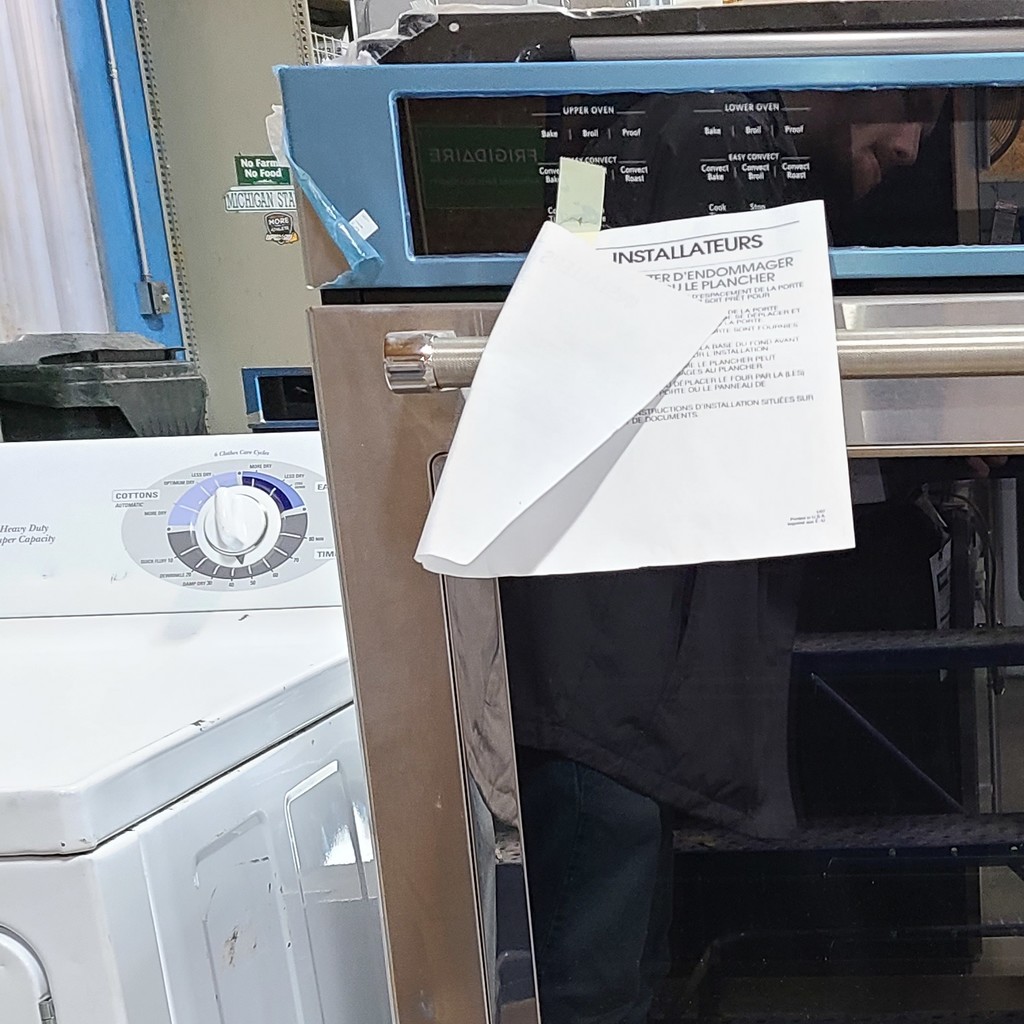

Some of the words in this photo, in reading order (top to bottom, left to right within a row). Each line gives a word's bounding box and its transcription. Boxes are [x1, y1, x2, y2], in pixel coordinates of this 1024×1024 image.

[563, 106, 589, 115] UPPER
[591, 106, 615, 115] OVEN
[725, 103, 754, 112] LOWER
[756, 103, 780, 111] OVEN
[582, 129, 598, 138] Broil
[622, 128, 641, 137] Proof
[704, 127, 722, 136] Bake
[745, 126, 762, 134] Broil
[784, 125, 804, 134] Proof
[541, 130, 558, 139] Bake
[728, 153, 746, 161] EASY
[747, 152, 780, 160] CONVECT
[241, 159, 254, 168] No
[256, 159, 280, 168] Farm
[741, 163, 770, 172] Convect
[782, 162, 810, 171] Convect
[244, 169, 258, 178] No
[260, 168, 282, 178] Food
[539, 167, 560, 175] Conve
[620, 166, 648, 174] Convect
[701, 164, 729, 173] Convect
[545, 175, 559, 184] Bak
[625, 174, 644, 182] Roast
[707, 173, 724, 181] Bake
[748, 172, 764, 180] Broil
[787, 171, 806, 180] Roast
[227, 191, 275, 208] MICHIGAN
[278, 191, 296, 208] STA
[708, 204, 727, 212] Cook
[268, 217, 290, 225] MORE
[613, 234, 763, 264] INSTALLATEURS
[674, 257, 794, 282] D'ENDOMMAGER
[685, 282, 698, 291] LE
[702, 272, 776, 290] PLANCHER
[778, 282, 804, 290] PORTE
[718, 363, 763, 373] PLANCHER
[688, 386, 700, 394] OU
[714, 382, 754, 391] PANNEAU
[636, 405, 693, 416] NSTRUCTIONS
[115, 491, 158, 501] COTTONS
[0, 524, 26, 534] Heavy
[29, 524, 49, 534] Duty
[18, 534, 56, 545] Capacity
